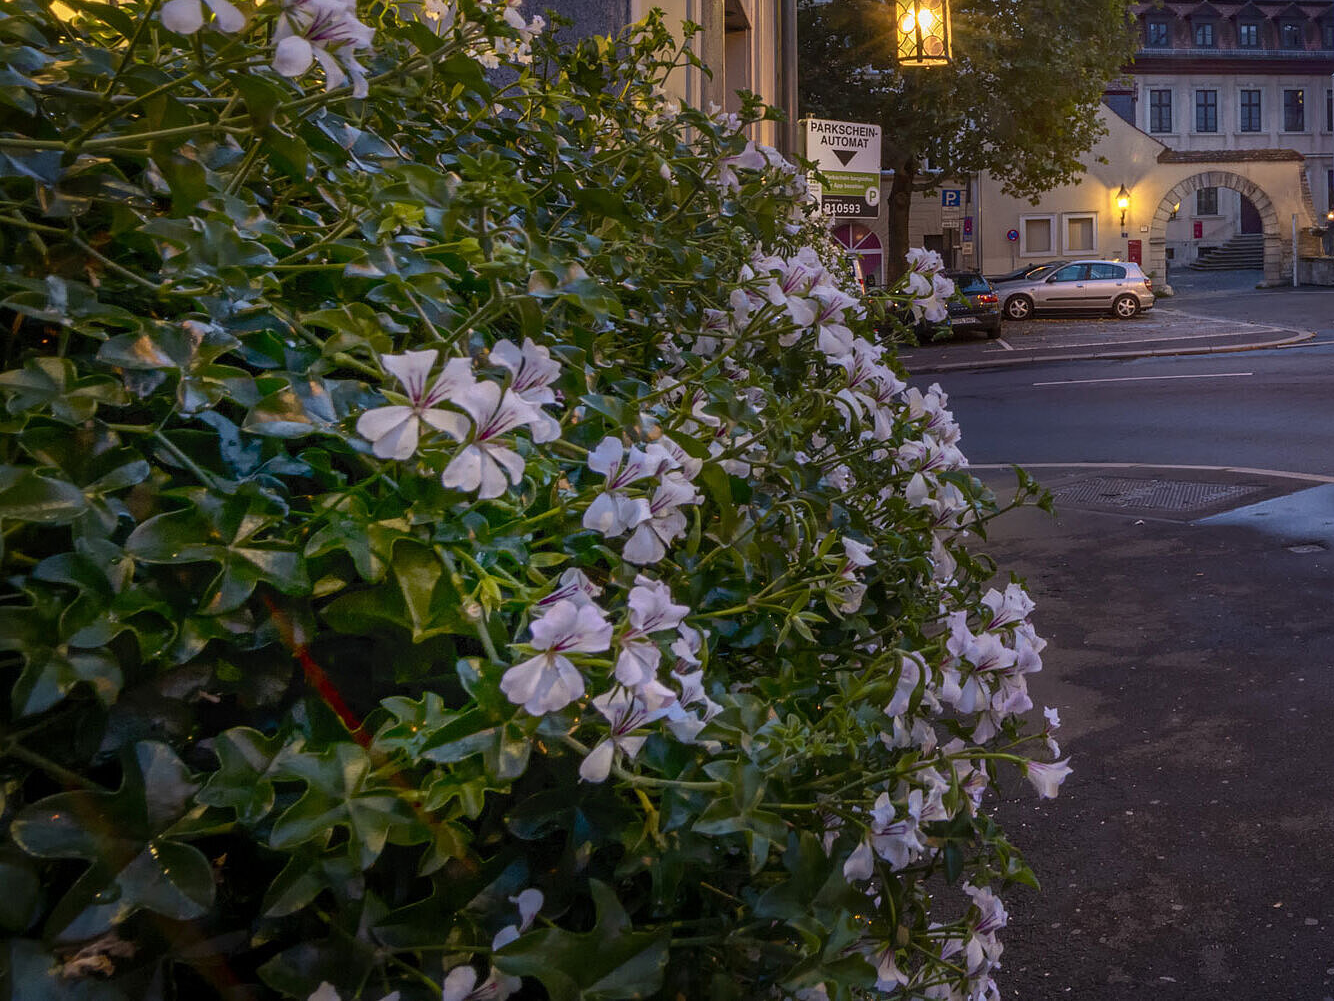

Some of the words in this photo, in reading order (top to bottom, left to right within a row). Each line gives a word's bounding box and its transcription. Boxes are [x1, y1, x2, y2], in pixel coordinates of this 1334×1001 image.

[810, 121, 878, 137] PARKSCHEIN-
[820, 135, 869, 148] AUTOMAT
[945, 191, 957, 206] P
